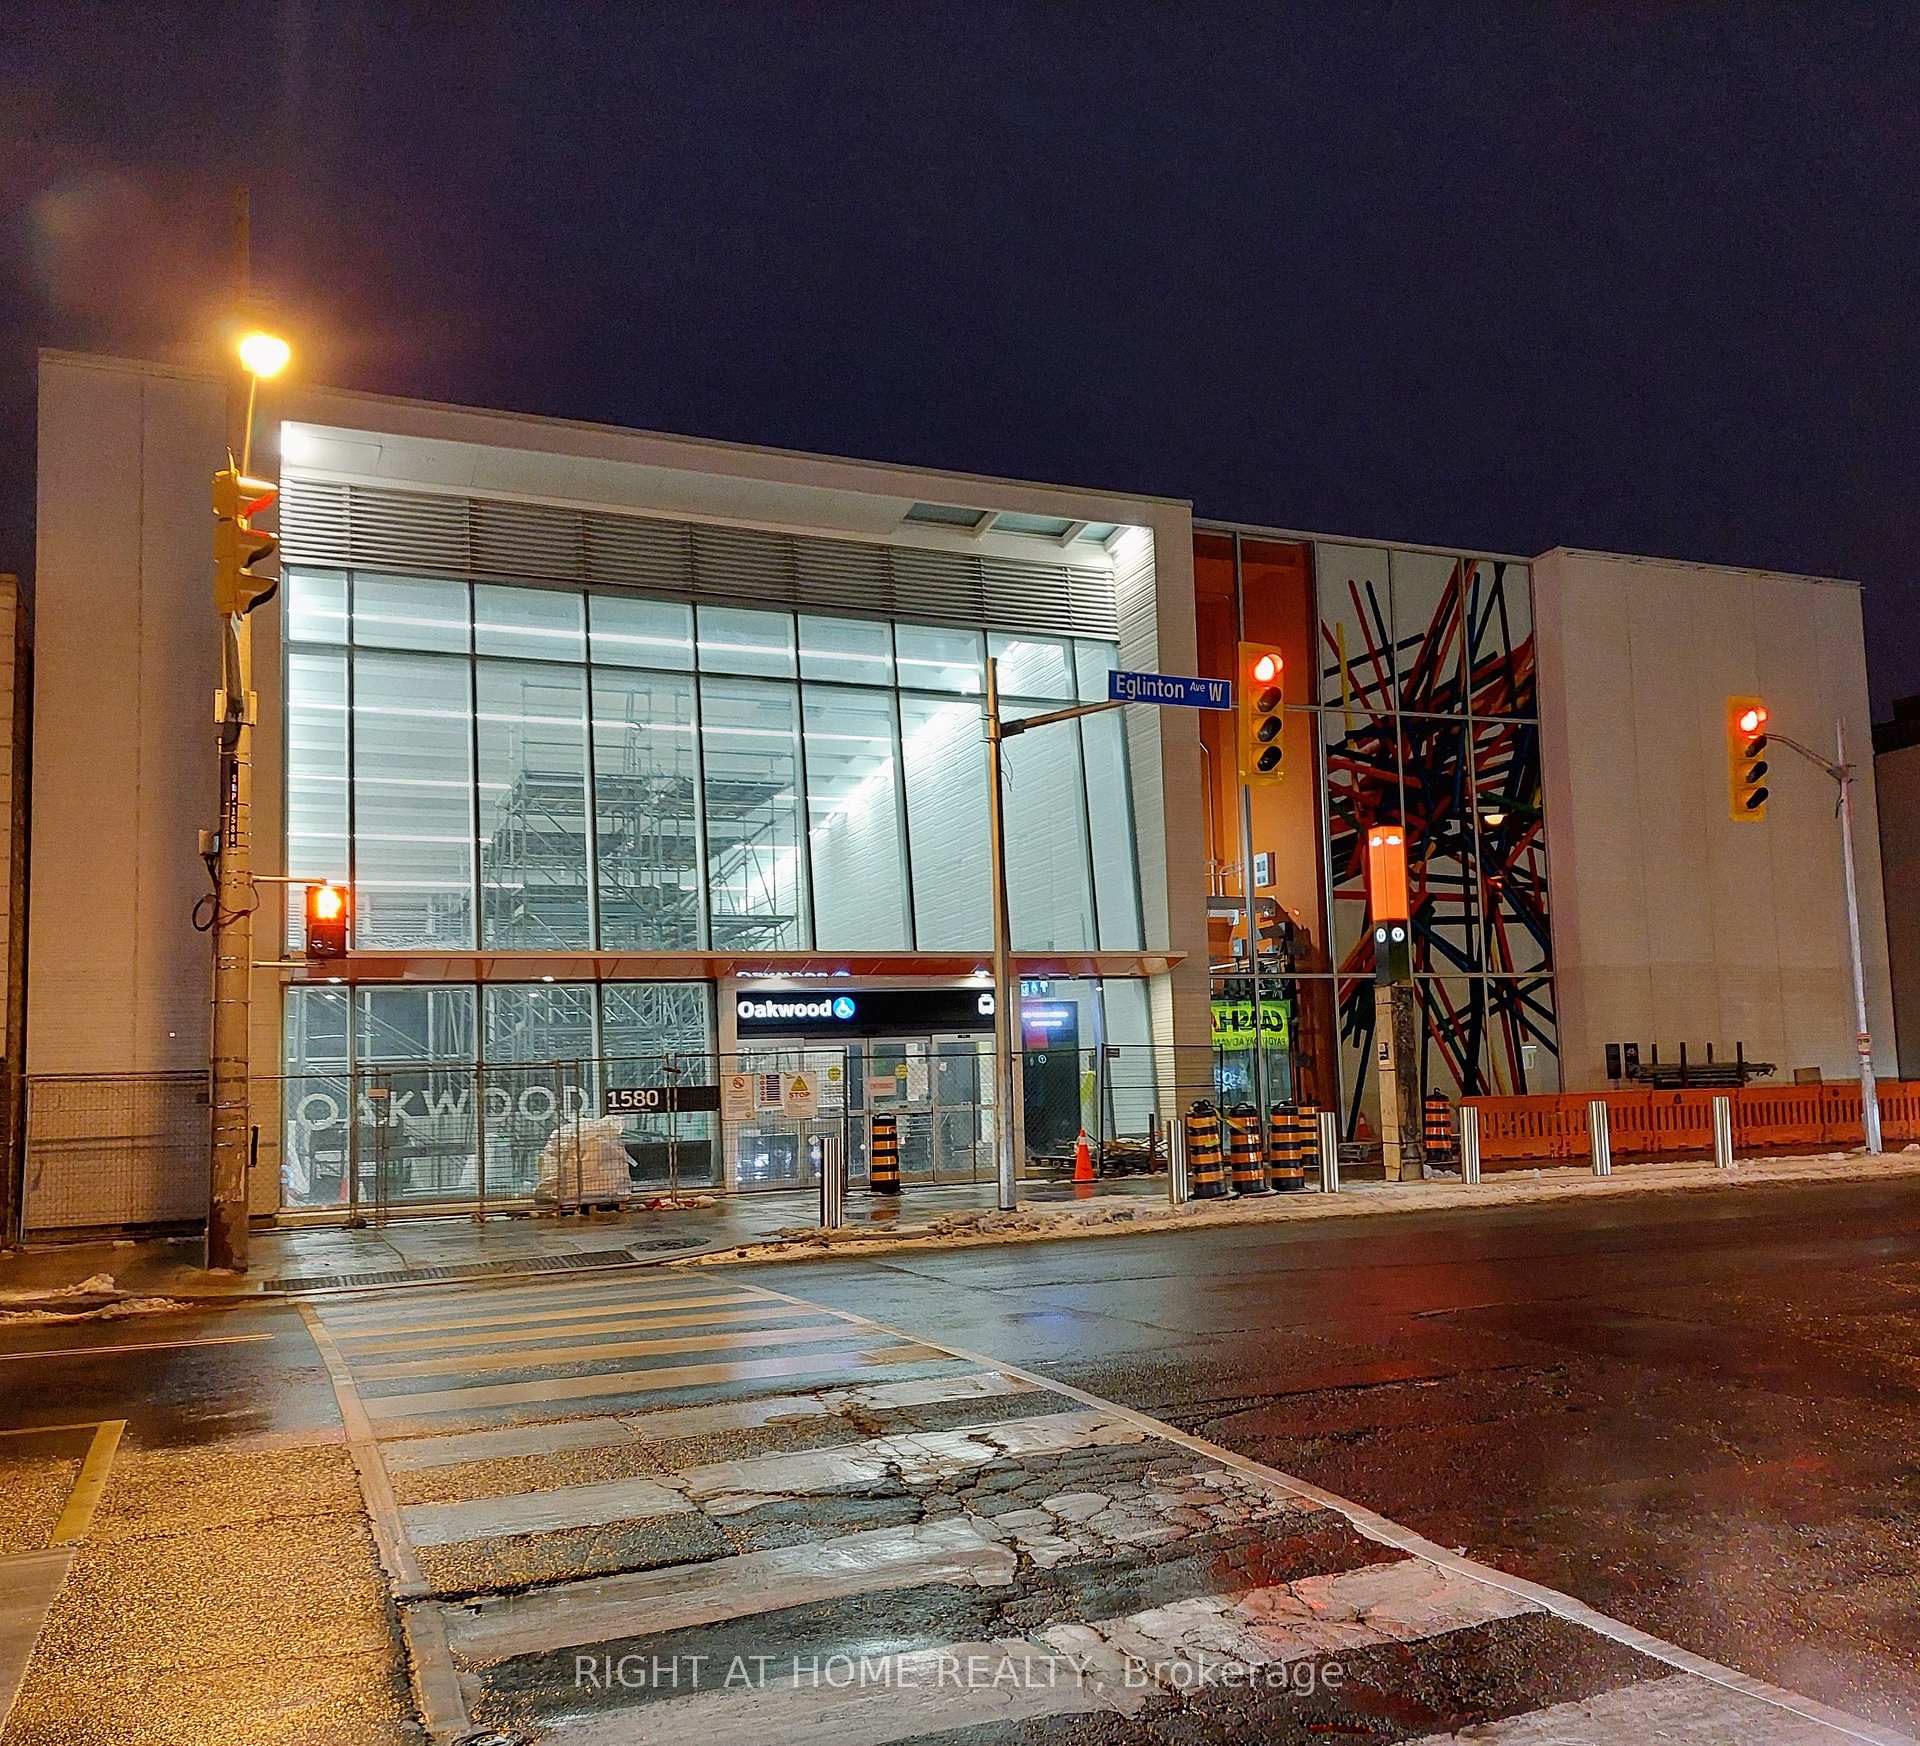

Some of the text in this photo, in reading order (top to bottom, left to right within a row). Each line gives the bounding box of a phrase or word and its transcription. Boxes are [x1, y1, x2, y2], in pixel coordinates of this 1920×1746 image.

[1116, 674, 1222, 702] Eglinton Ave W
[737, 999, 832, 1018] Oakwood
[608, 1090, 659, 1108] 1580
[789, 1091, 811, 1099] STOP
[297, 1086, 590, 1130] OAKWOOD
